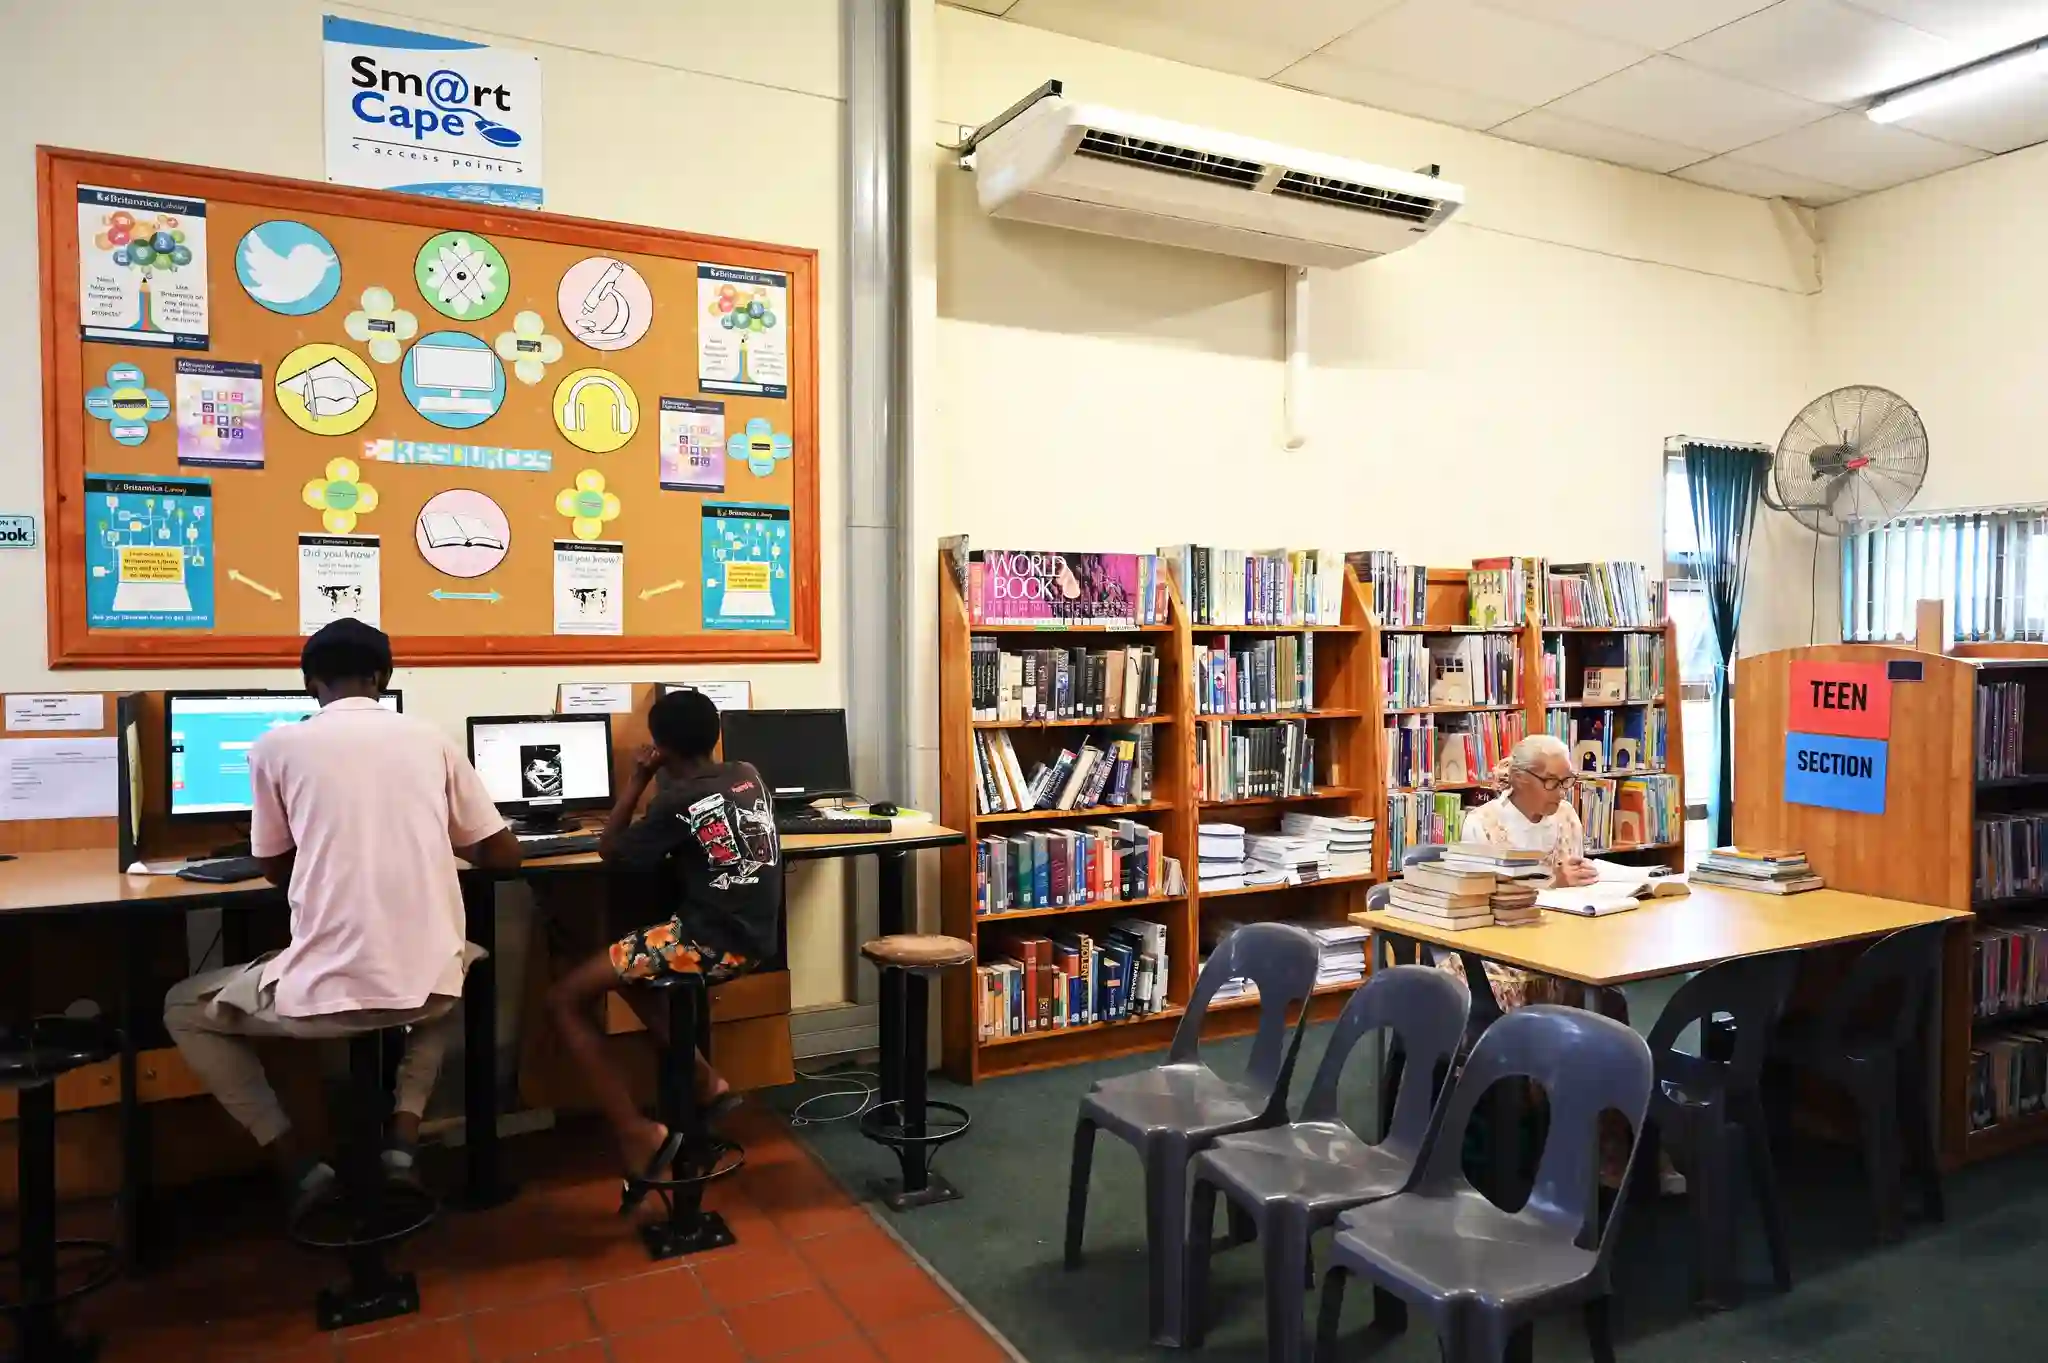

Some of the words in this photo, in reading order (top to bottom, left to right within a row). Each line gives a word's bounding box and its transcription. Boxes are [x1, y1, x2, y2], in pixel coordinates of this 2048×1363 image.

[351, 56, 511, 111] Sm@rt
[352, 91, 465, 140] Cape
[374, 147, 439, 162] access
[453, 159, 503, 172] point
[110, 194, 160, 209] Britannica
[720, 271, 754, 281] Britannica
[123, 483, 164, 492] Britannica
[303, 548, 321, 557] Did
[323, 551, 343, 561] you
[344, 549, 376, 559] know?
[557, 553, 573, 562] Did
[575, 556, 591, 565] you
[990, 553, 1065, 578] WORLD
[994, 577, 1055, 600] BOOK
[1810, 680, 1868, 711] TEEN
[1797, 749, 1873, 779] SECTION
[1081, 936, 1090, 984] VIOLENT
